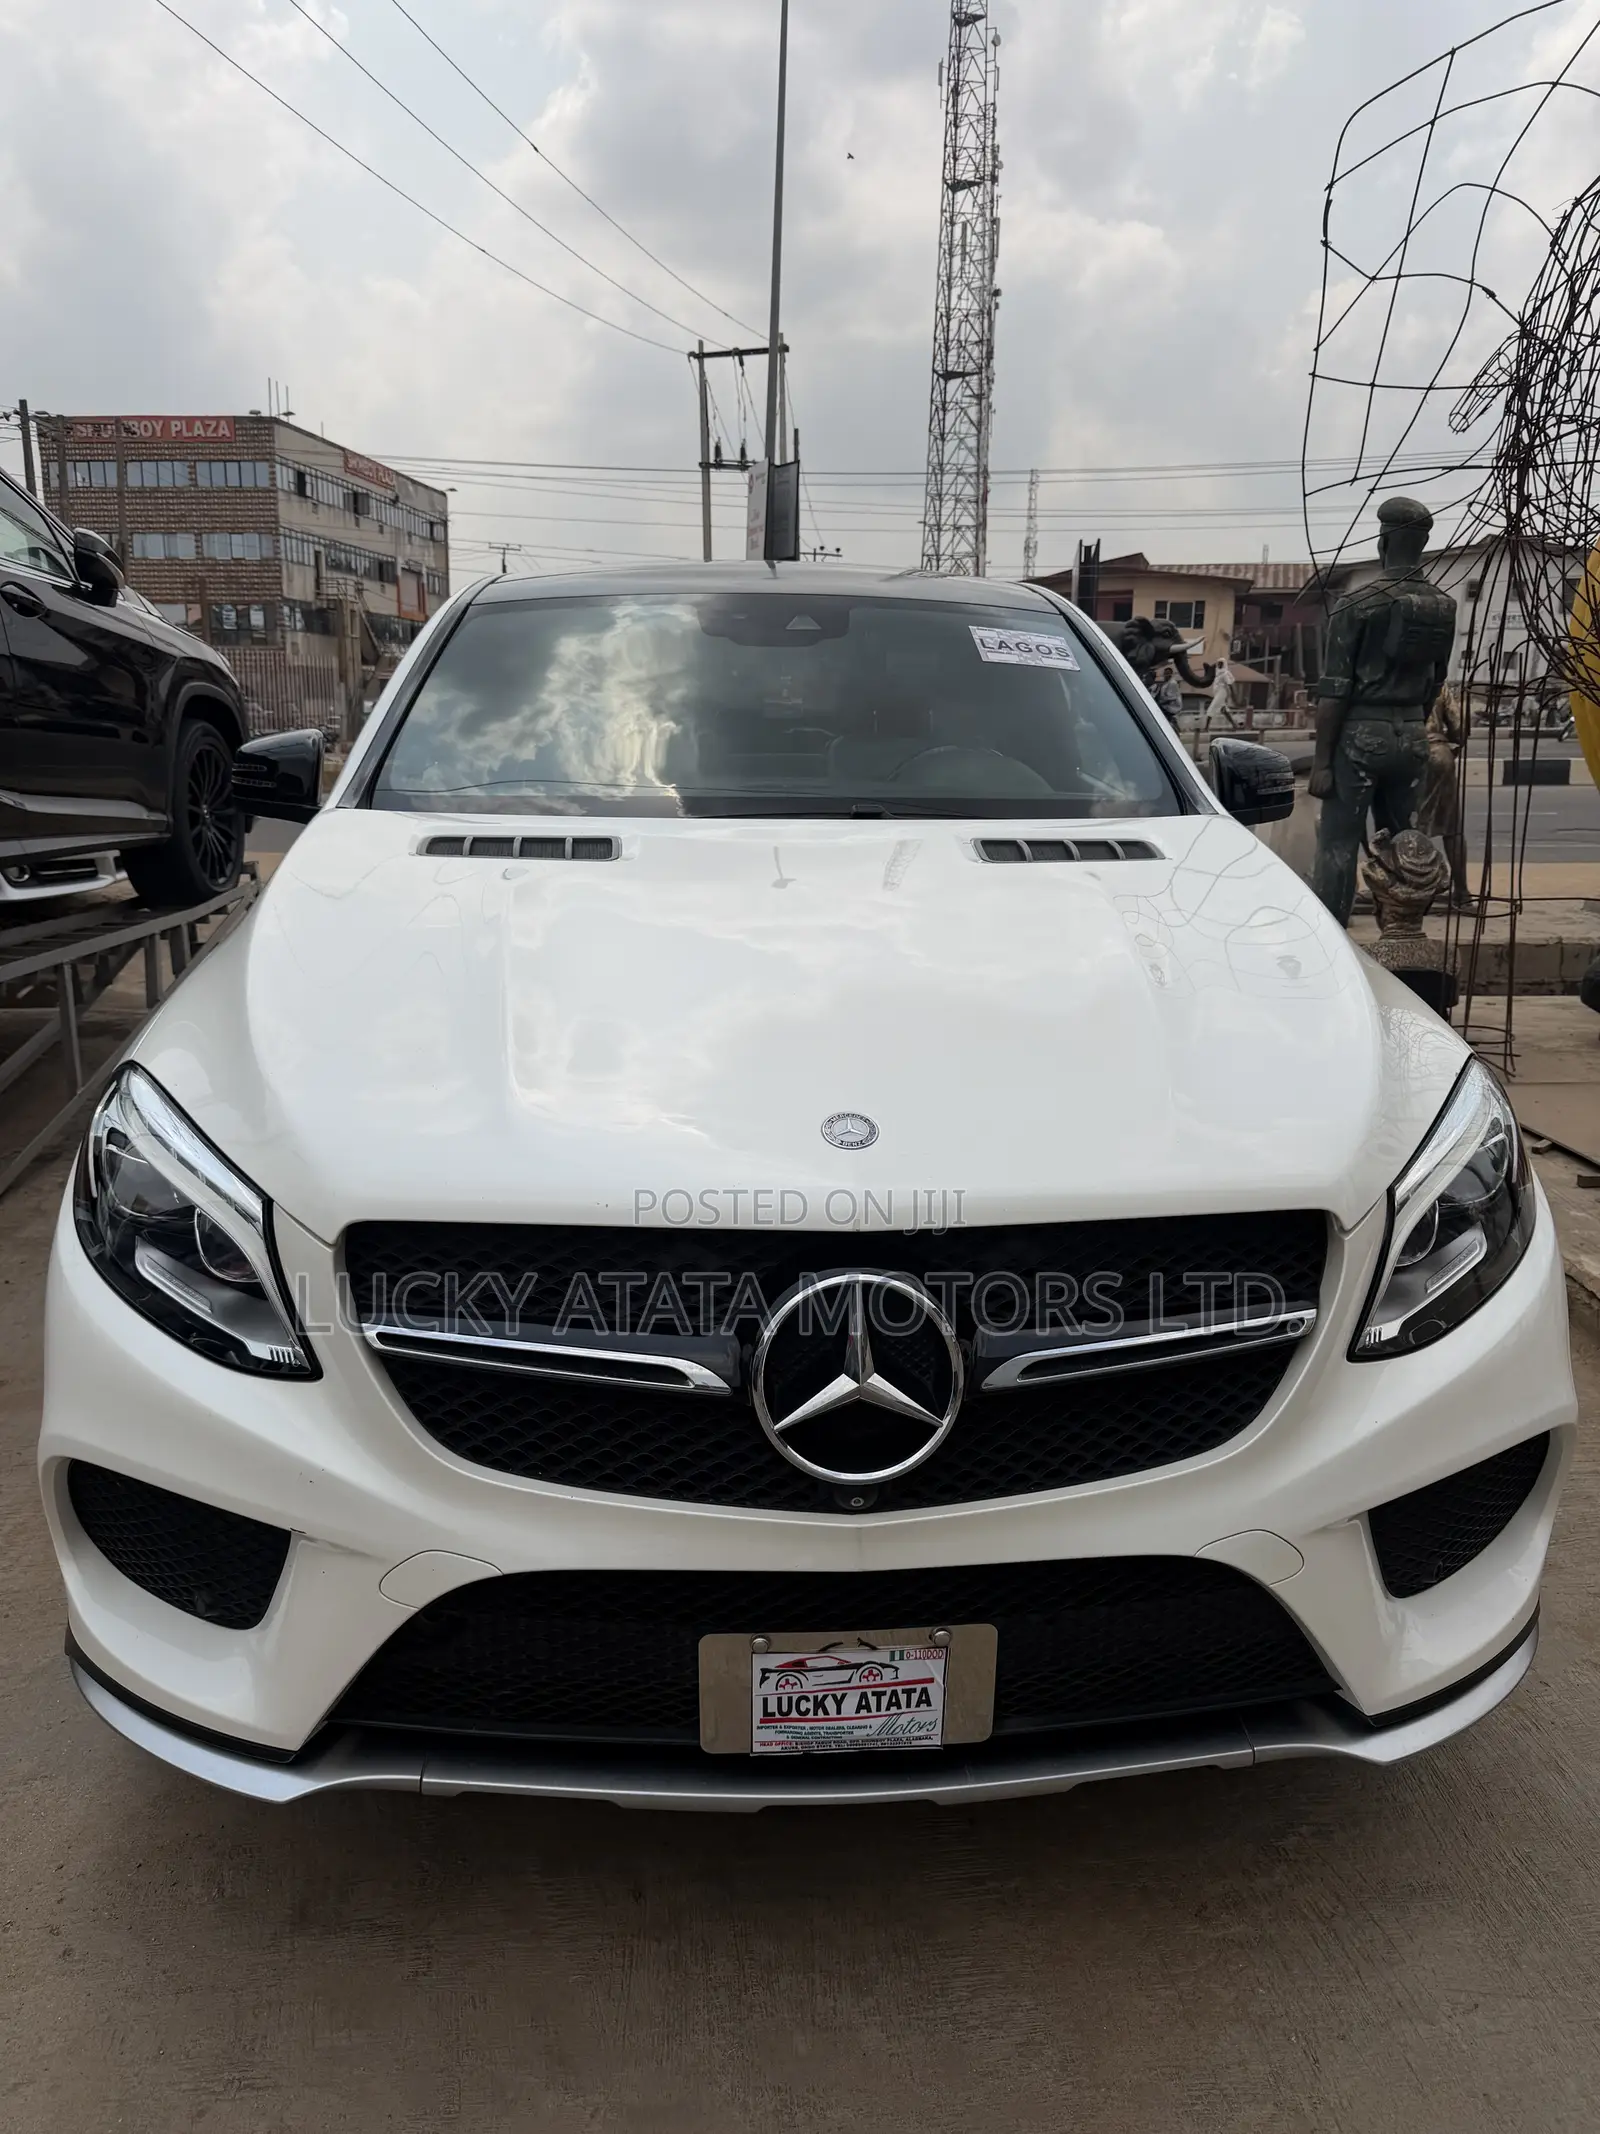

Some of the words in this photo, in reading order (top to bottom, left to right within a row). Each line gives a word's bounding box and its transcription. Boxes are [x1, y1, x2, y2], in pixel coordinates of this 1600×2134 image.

[170, 419, 232, 438] PLAZA
[979, 638, 1070, 657] LAGOS
[762, 1692, 847, 1718] LUCKY
[855, 1686, 932, 1714] ATATA
[866, 1713, 939, 1737] Motors
